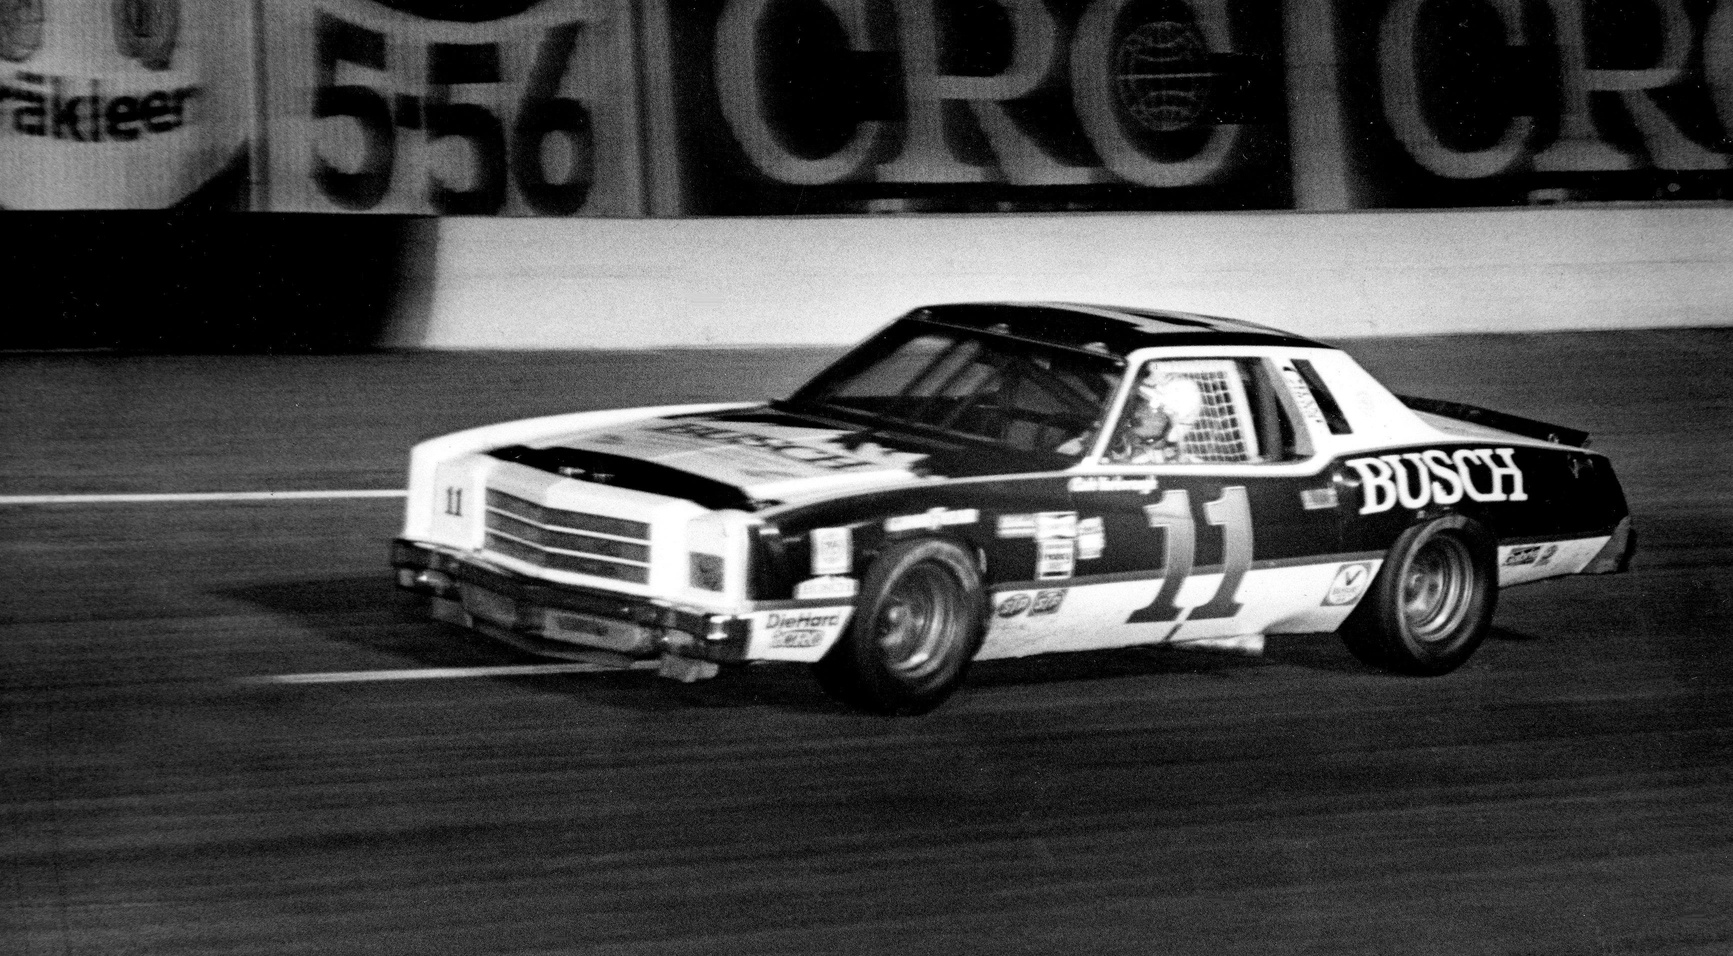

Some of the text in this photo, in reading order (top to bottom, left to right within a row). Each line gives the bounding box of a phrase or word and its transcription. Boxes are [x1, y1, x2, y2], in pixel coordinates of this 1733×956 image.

[714, 0, 1240, 187] CRC
[1379, 0, 1733, 179] CR
[445, 486, 462, 517] 11
[1345, 448, 1528, 515] BUSCH
[1124, 486, 1253, 624] 11
